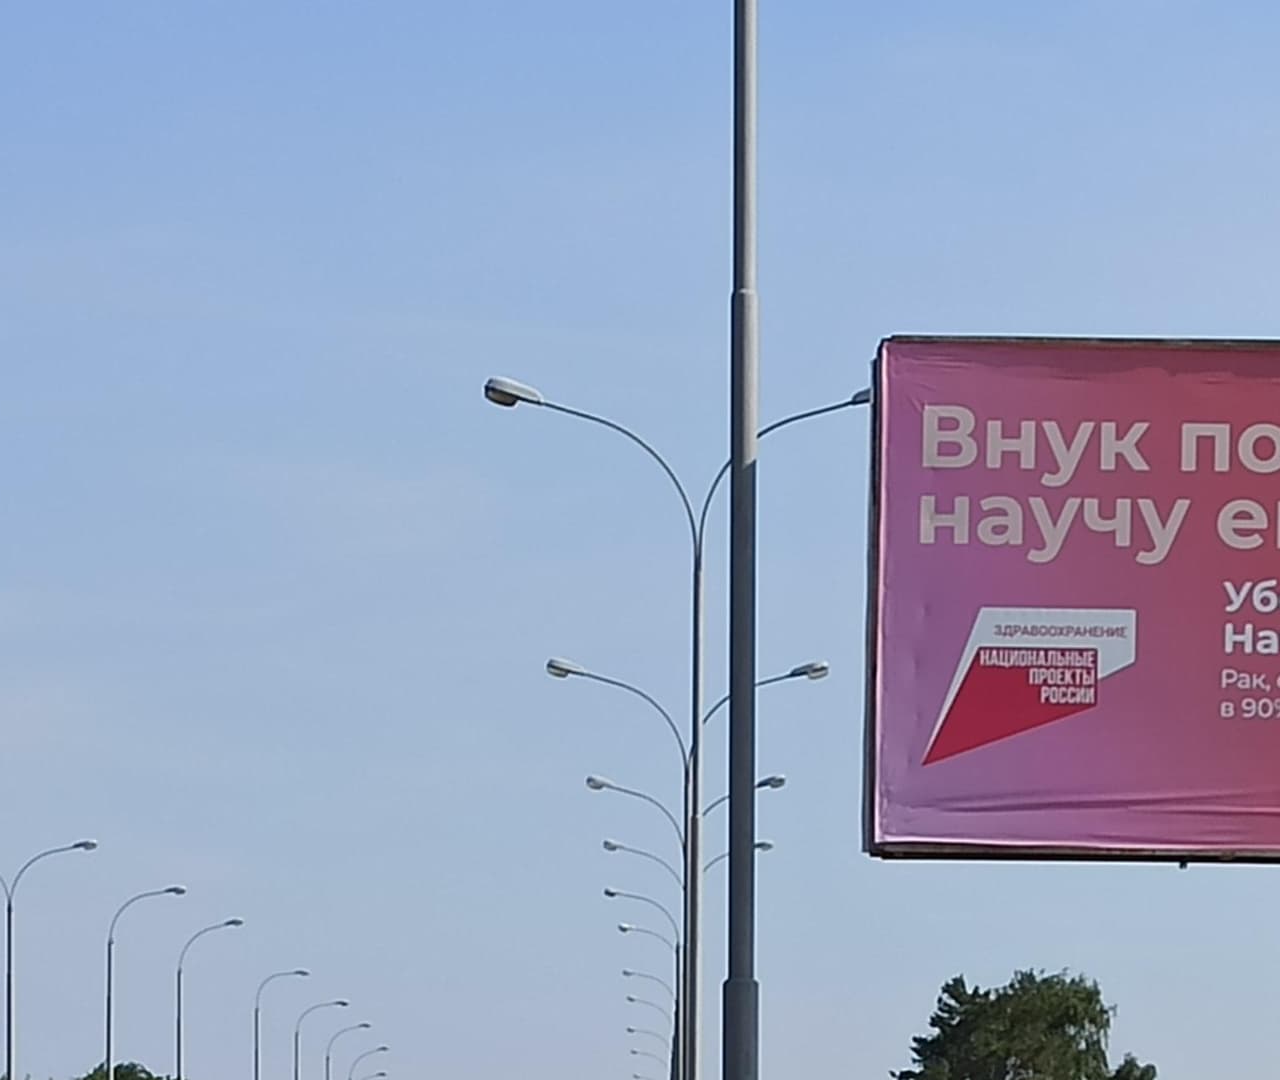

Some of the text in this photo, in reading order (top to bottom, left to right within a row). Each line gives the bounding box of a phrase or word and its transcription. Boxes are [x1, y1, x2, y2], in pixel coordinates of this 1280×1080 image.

[921, 403, 1151, 488] Внук
[919, 494, 1192, 566] научу
[993, 624, 1129, 639] ЗДРАВООХРАНЕНИЕ
[979, 649, 1096, 669] НАЦИОНАЛЬНЫЕ
[1028, 668, 1096, 685] ПРОЕКТЫ
[1220, 668, 1272, 693] Рак,
[1039, 686, 1096, 704] РОССИИ
[1220, 700, 1235, 718] в
